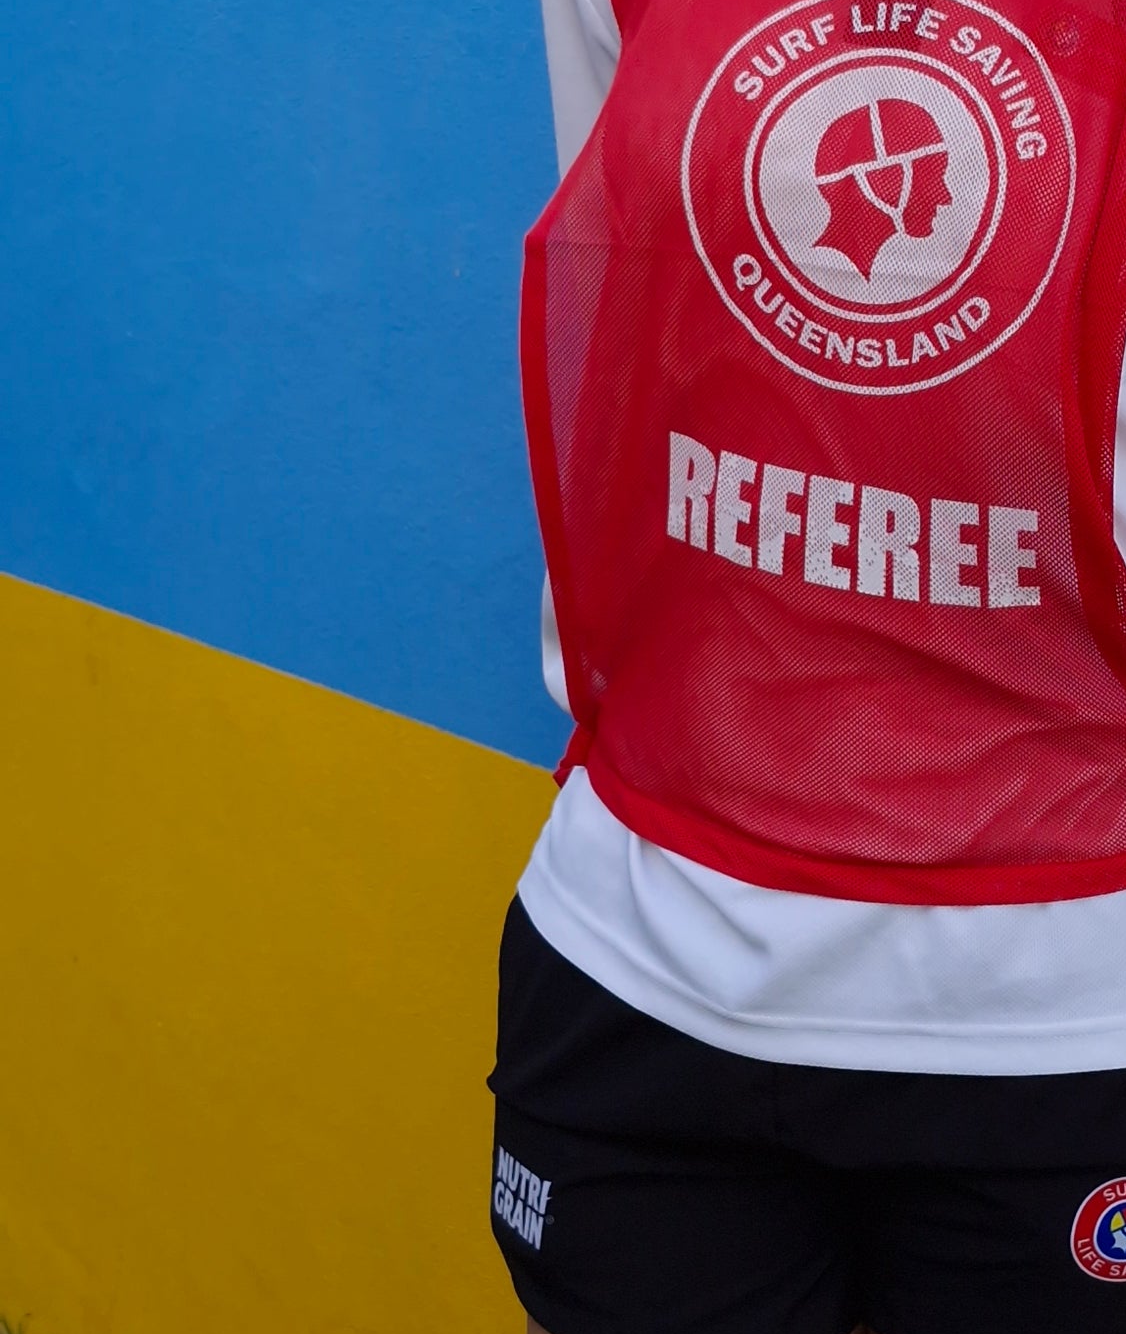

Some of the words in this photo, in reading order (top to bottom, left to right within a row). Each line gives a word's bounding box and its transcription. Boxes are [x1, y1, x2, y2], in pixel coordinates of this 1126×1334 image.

[734, 14, 834, 100] SURF
[850, 2, 948, 40] LIFE
[949, 26, 1048, 160] SAVING
[732, 254, 991, 367] QUEENSLAND
[666, 431, 1041, 609] REFEREE
[494, 1181, 543, 1250] GRAIN
[497, 1145, 552, 1214] NUTRI
[1077, 1238, 1105, 1271] LIFE
